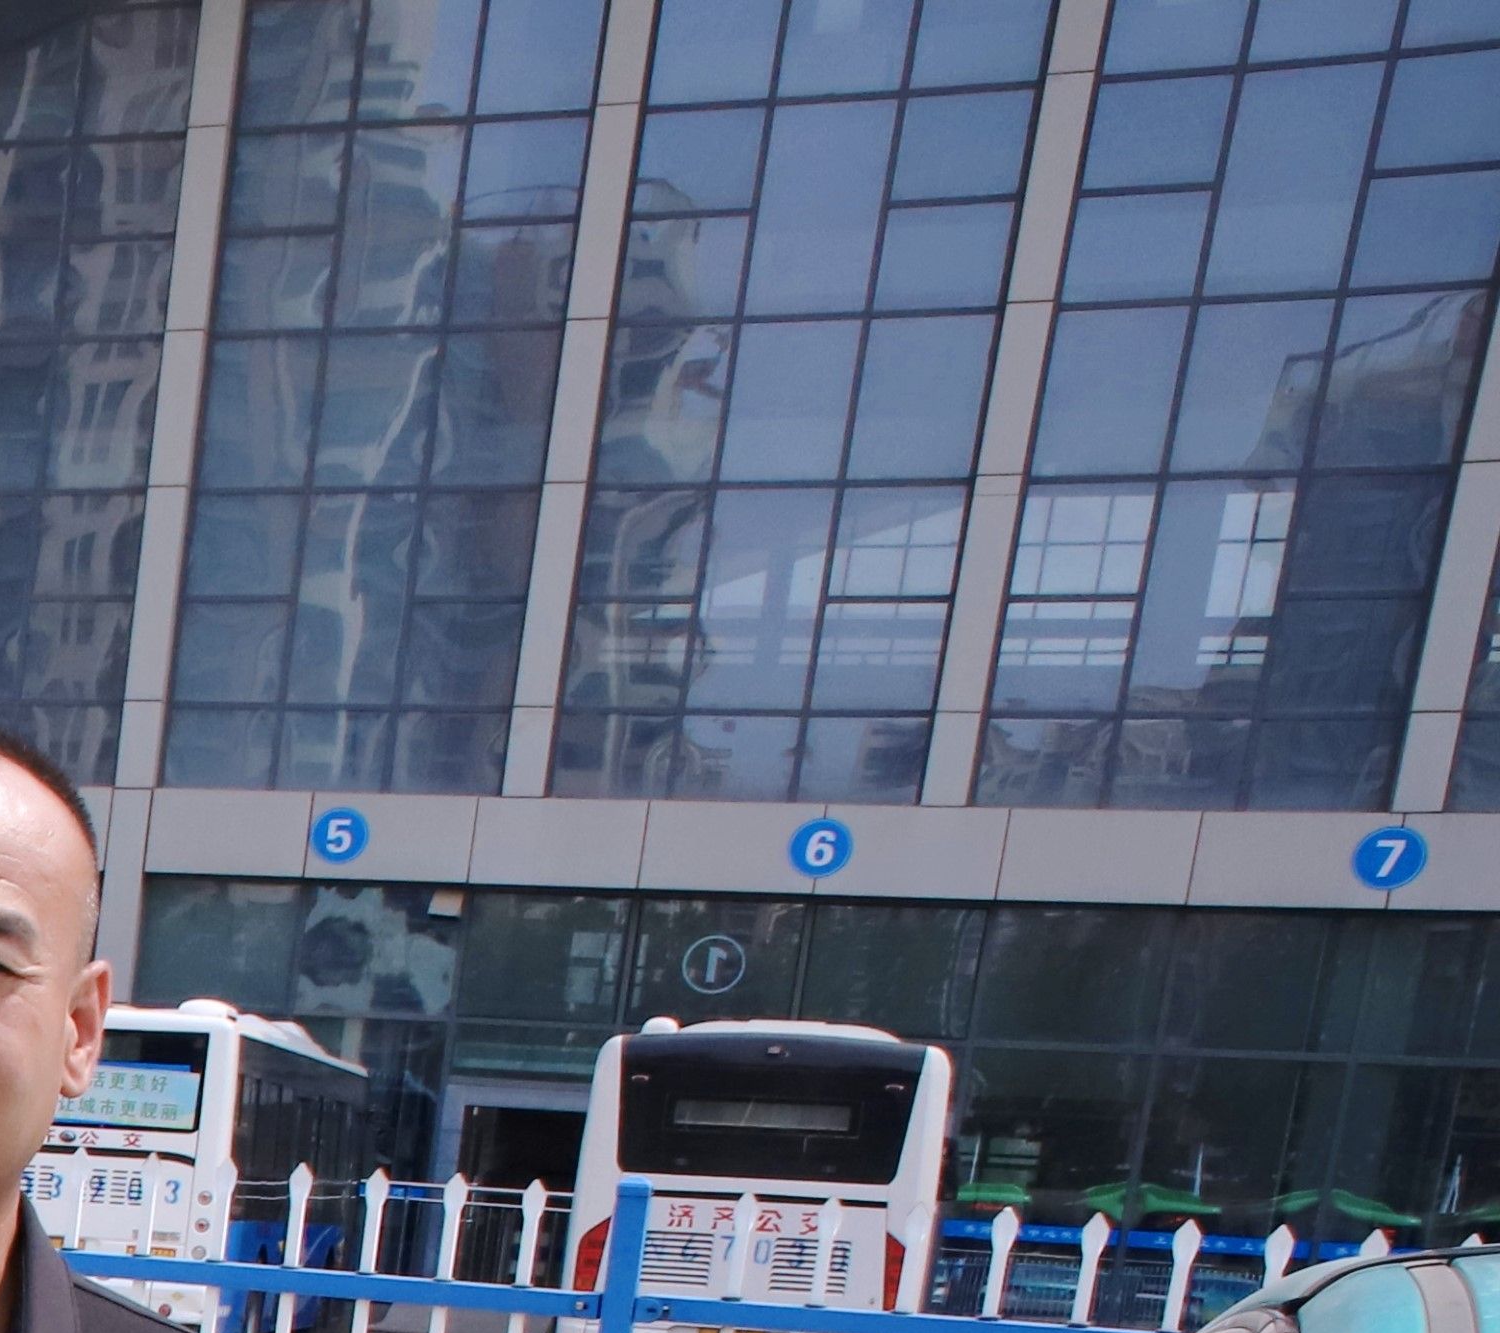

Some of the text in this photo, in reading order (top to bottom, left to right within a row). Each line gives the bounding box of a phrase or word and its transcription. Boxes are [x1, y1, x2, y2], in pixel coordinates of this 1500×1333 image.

[326, 817, 353, 854] 5
[805, 830, 836, 867] 6
[1378, 839, 1406, 876] 7
